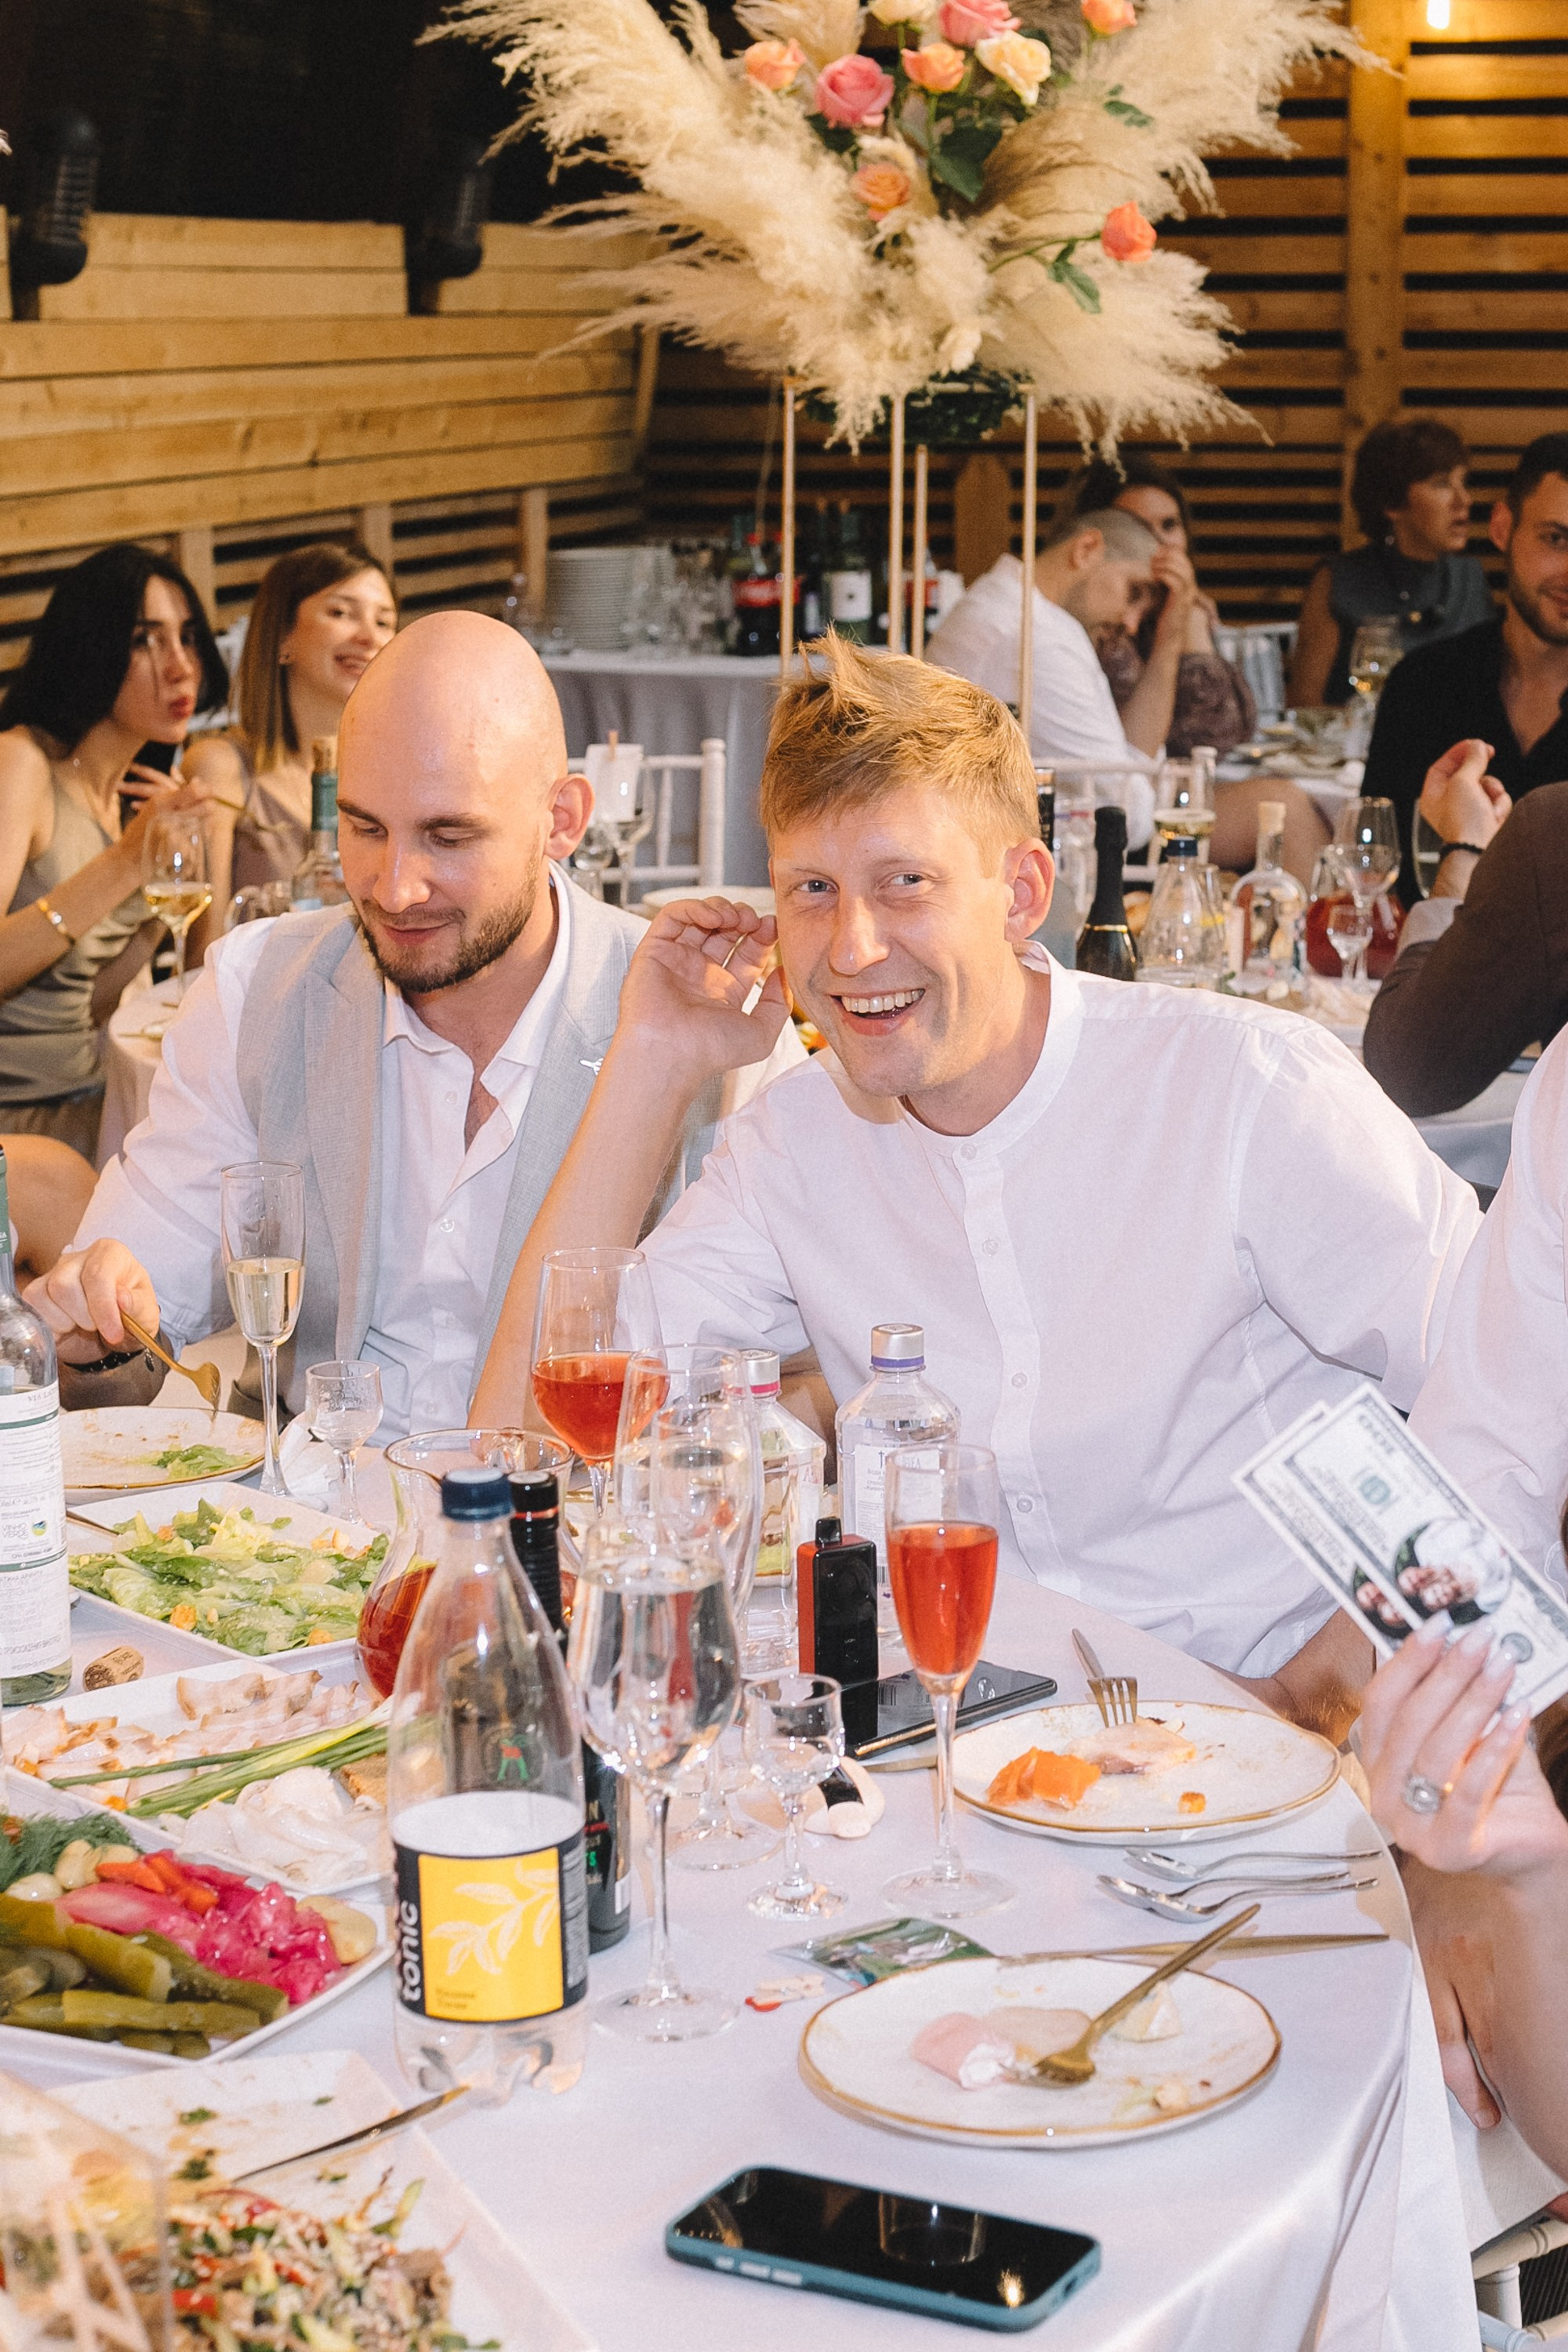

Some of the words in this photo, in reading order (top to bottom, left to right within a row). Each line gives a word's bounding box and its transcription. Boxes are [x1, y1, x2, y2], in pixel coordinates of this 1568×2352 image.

[2, 1522, 27, 1532] VINHO
[2, 1530, 29, 1541] VERDE
[400, 1900, 421, 2002] tonic
